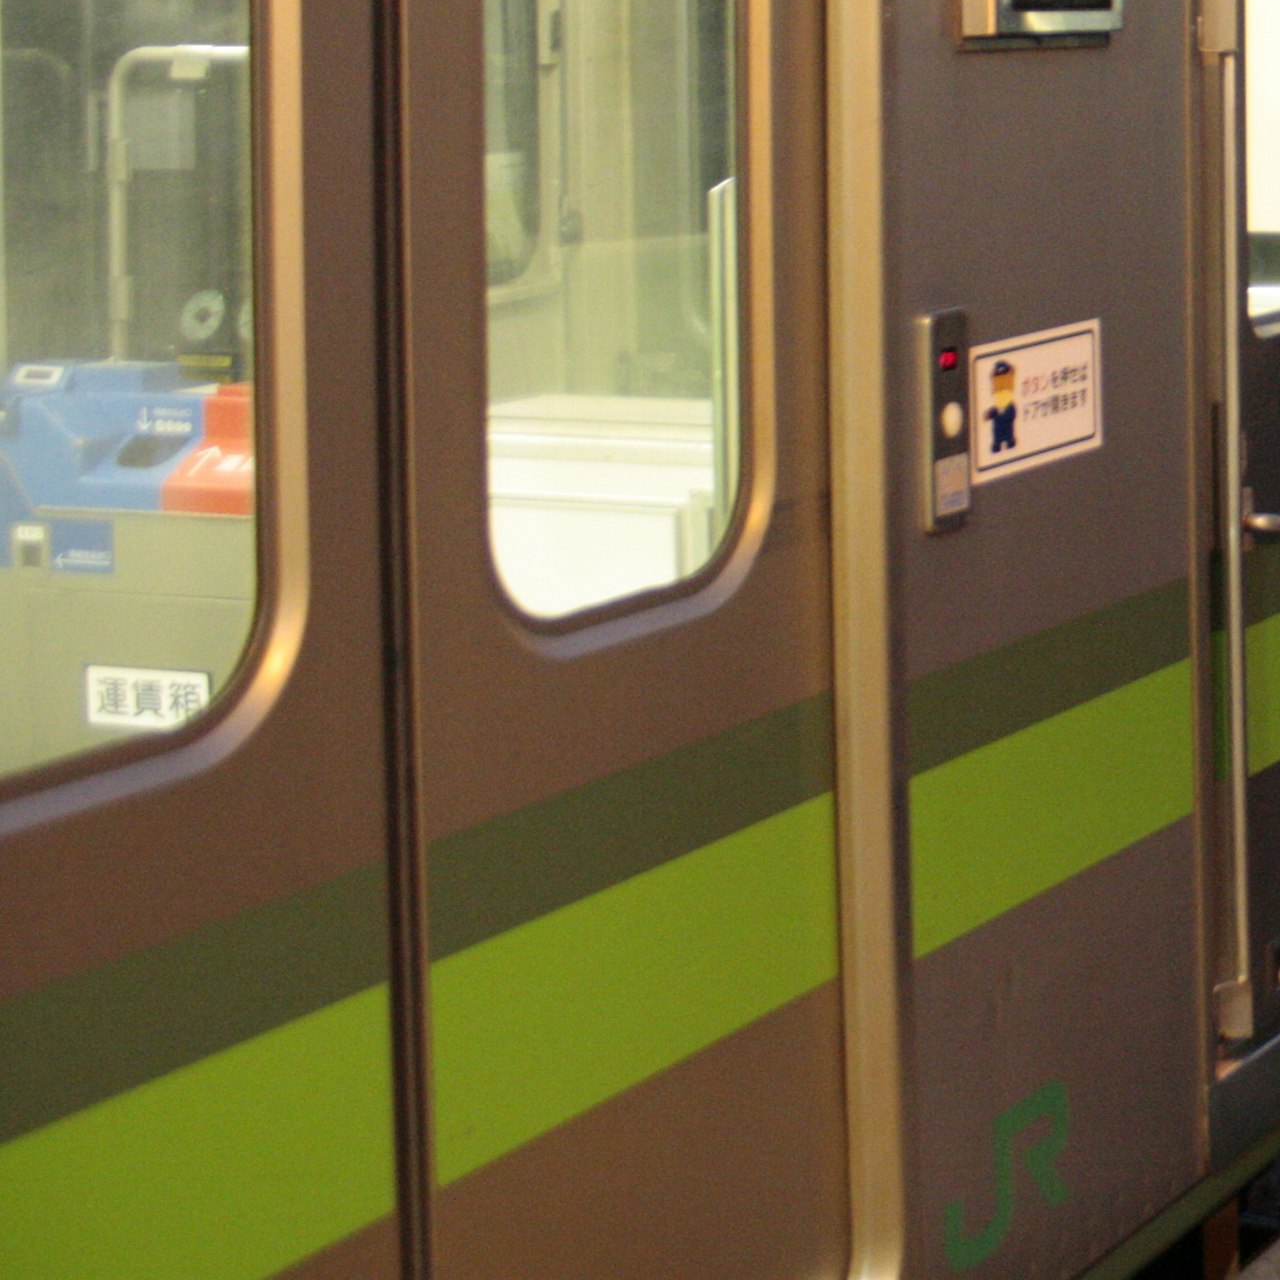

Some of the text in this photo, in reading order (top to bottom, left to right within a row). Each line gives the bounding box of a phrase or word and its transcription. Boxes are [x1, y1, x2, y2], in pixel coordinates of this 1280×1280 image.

[97, 676, 202, 721] 運賃箱
[944, 1079, 1071, 1271] JR
